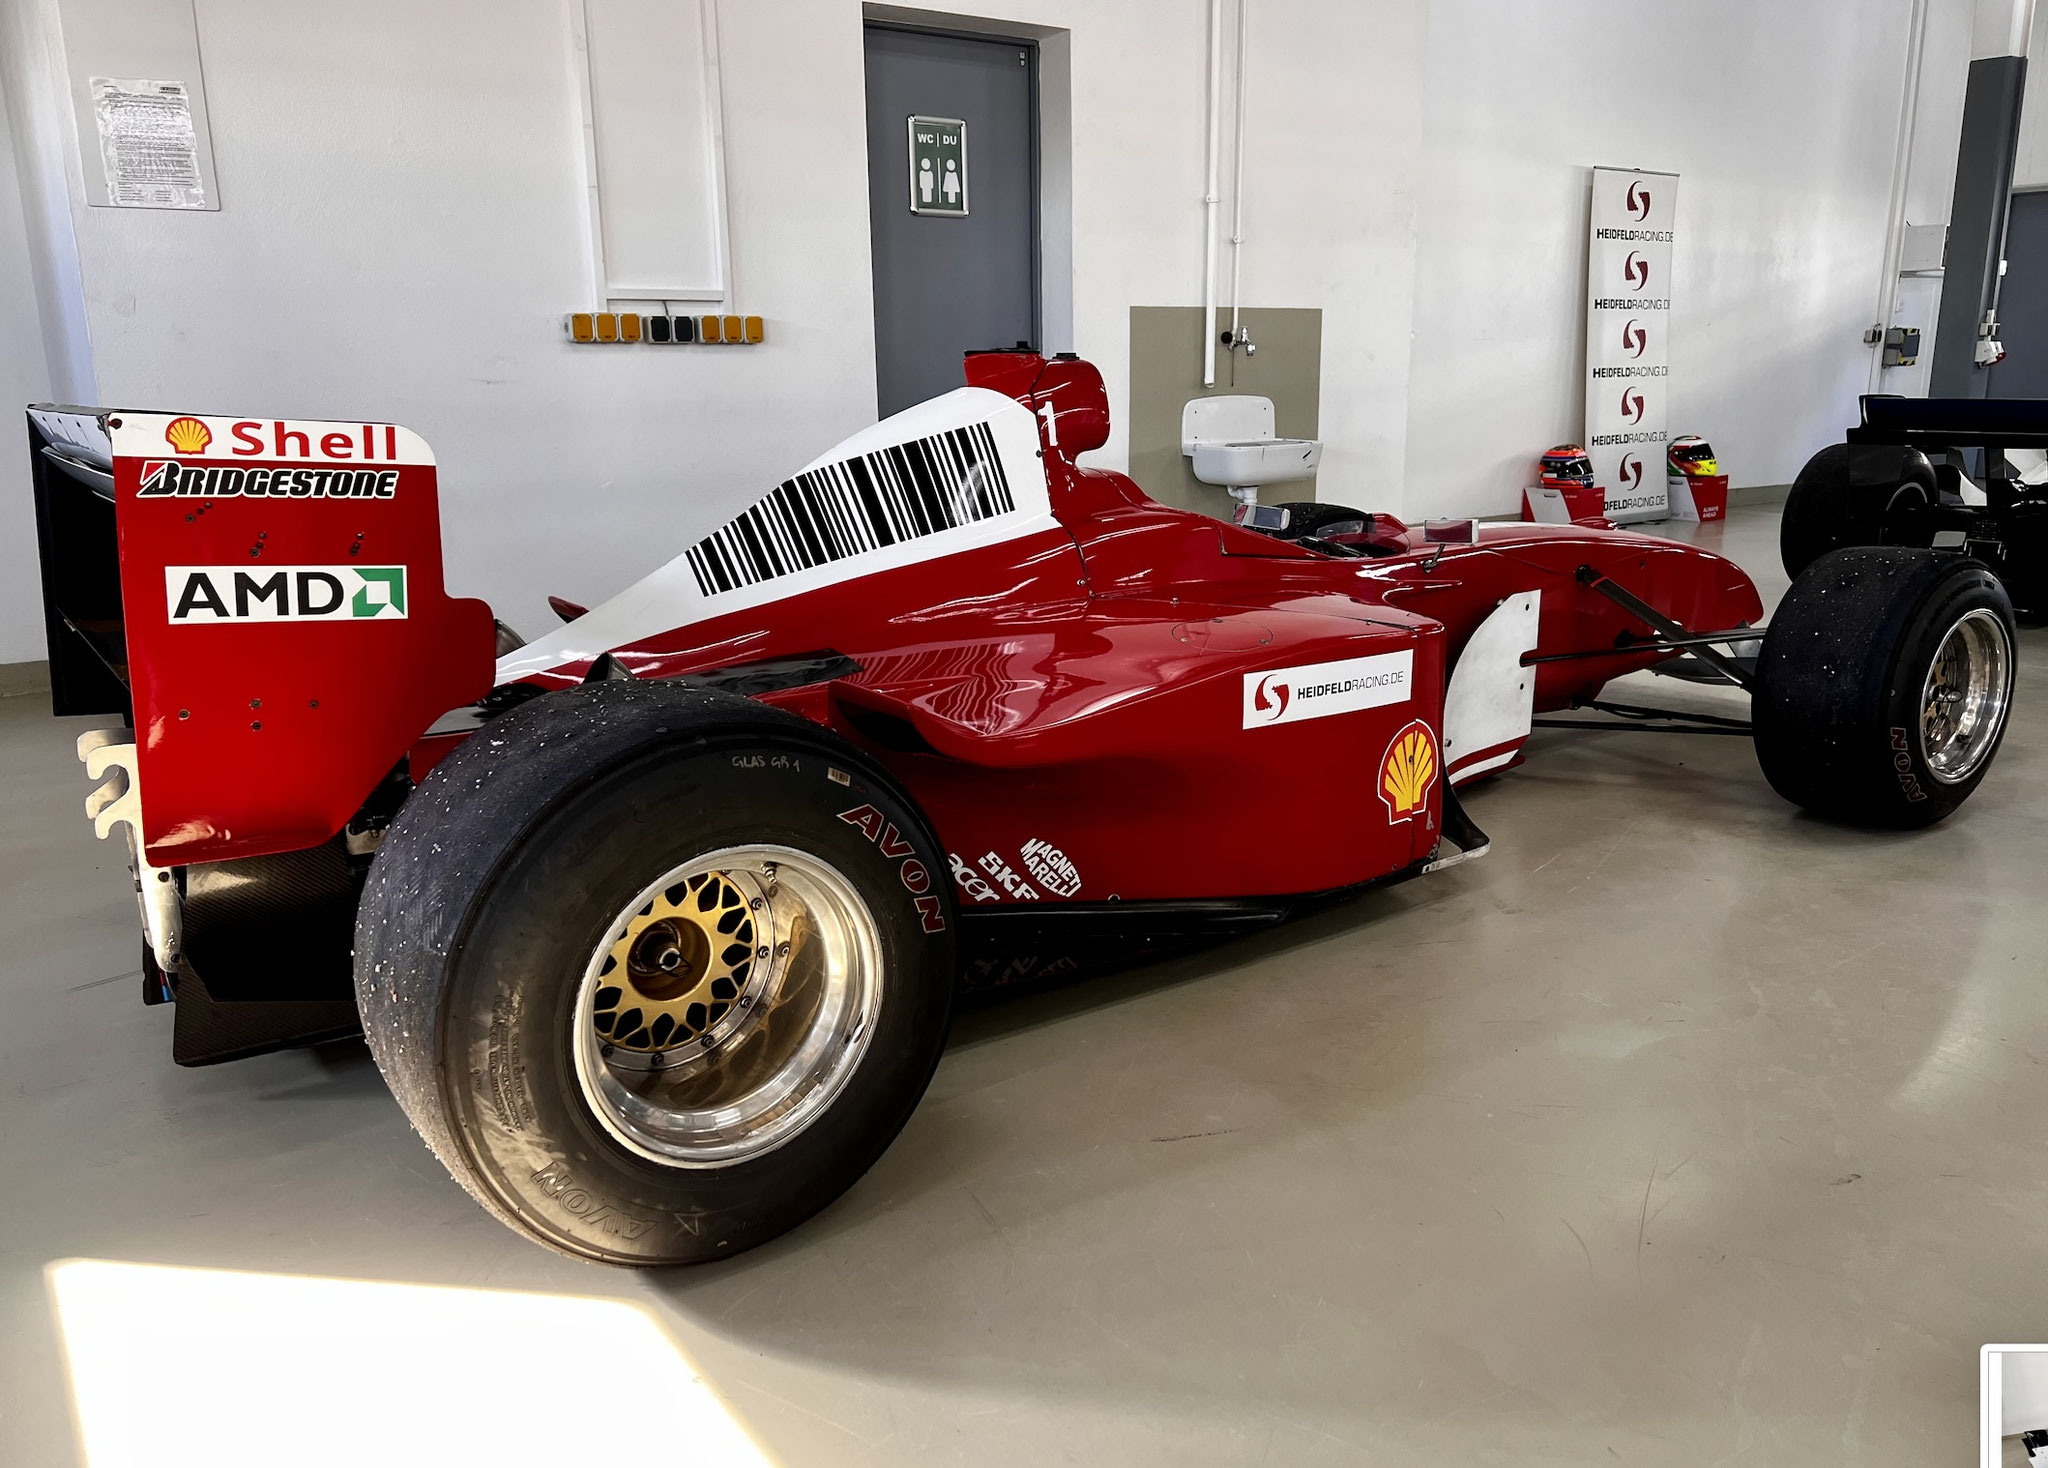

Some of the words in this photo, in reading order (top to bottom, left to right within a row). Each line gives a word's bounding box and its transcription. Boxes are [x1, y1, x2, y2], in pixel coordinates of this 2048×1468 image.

[917, 133, 934, 144] WC
[943, 135, 957, 146] DU
[231, 421, 397, 460] Shell
[1037, 401, 1058, 447] 1
[137, 460, 399, 499] BRIDGESTONE
[173, 571, 344, 618] AMD
[1297, 670, 1404, 700] HEIDFELDRACING.DE
[1890, 727, 1927, 803] AVON
[836, 803, 946, 934] AVON
[948, 853, 1001, 902] acer
[978, 850, 1040, 900] SKF
[1020, 838, 1082, 895] MAGNETI
[1020, 846, 1080, 898] MARELLI
[531, 1160, 658, 1240] AVON
